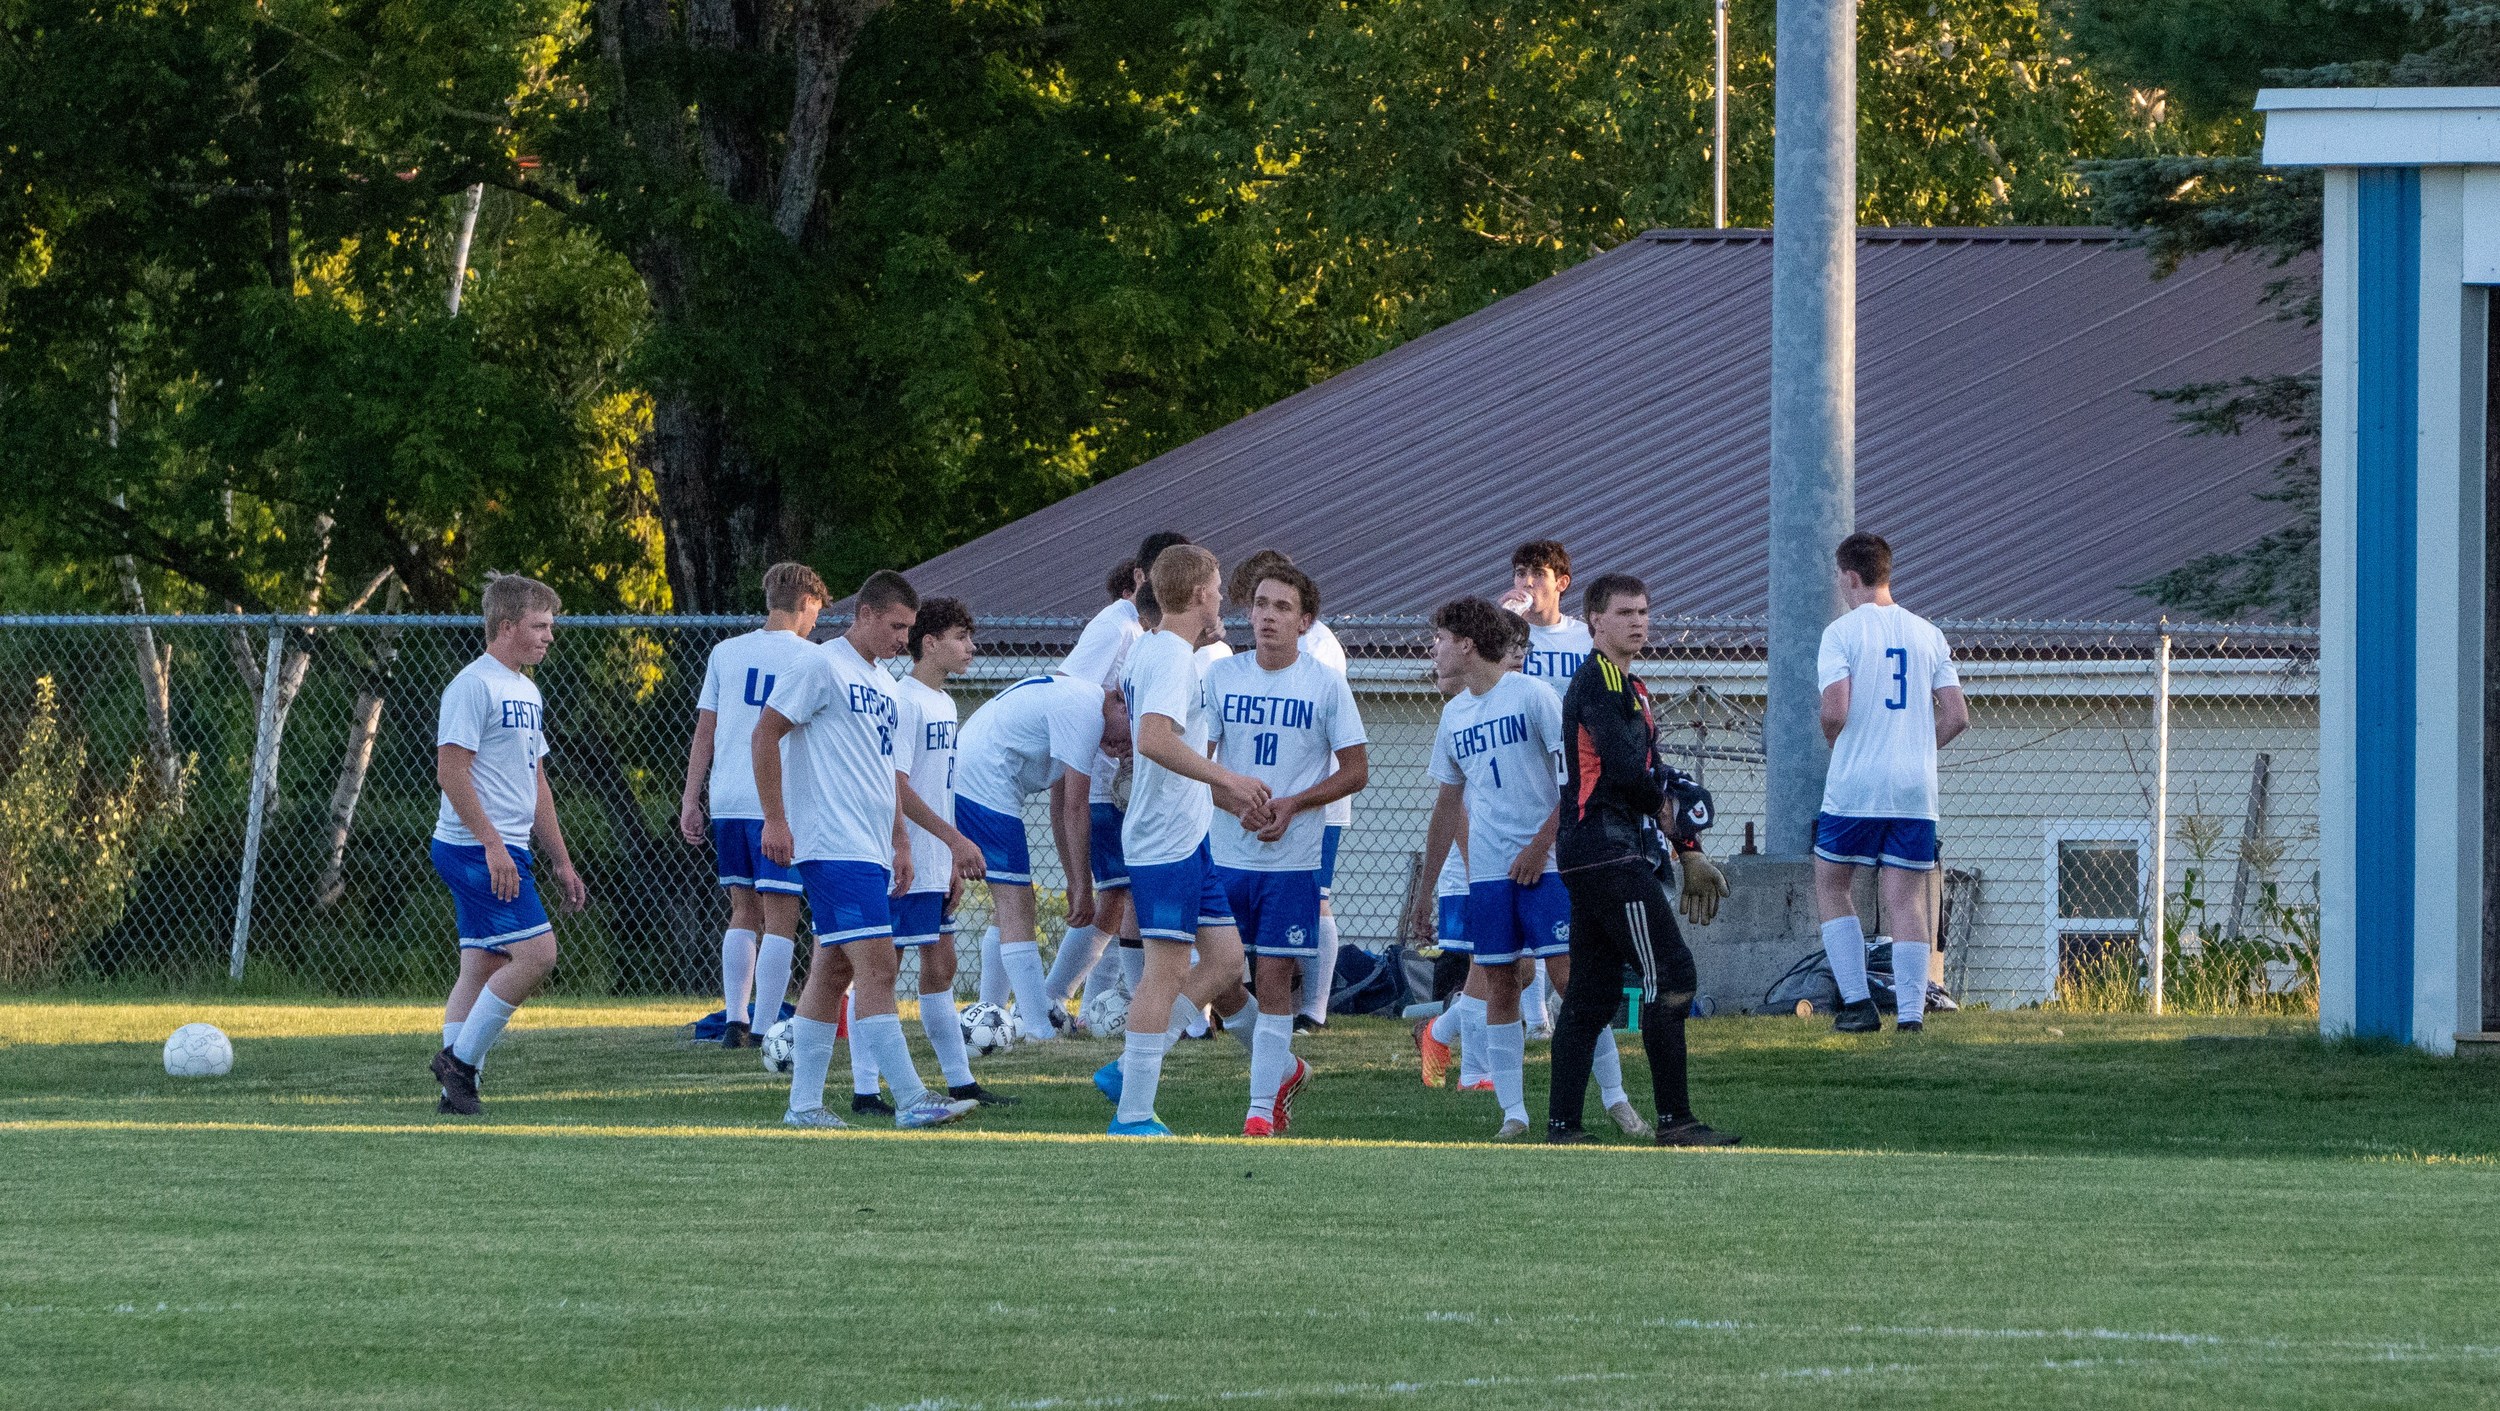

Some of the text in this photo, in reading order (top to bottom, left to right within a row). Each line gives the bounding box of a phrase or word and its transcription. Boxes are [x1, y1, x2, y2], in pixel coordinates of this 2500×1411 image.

[1885, 647, 1907, 710] 3
[501, 700, 543, 731] EASTO
[1223, 693, 1314, 730] EASTON
[1253, 732, 1279, 766] 10
[1452, 713, 1528, 760] EASTON
[1489, 756, 1502, 789] 1
